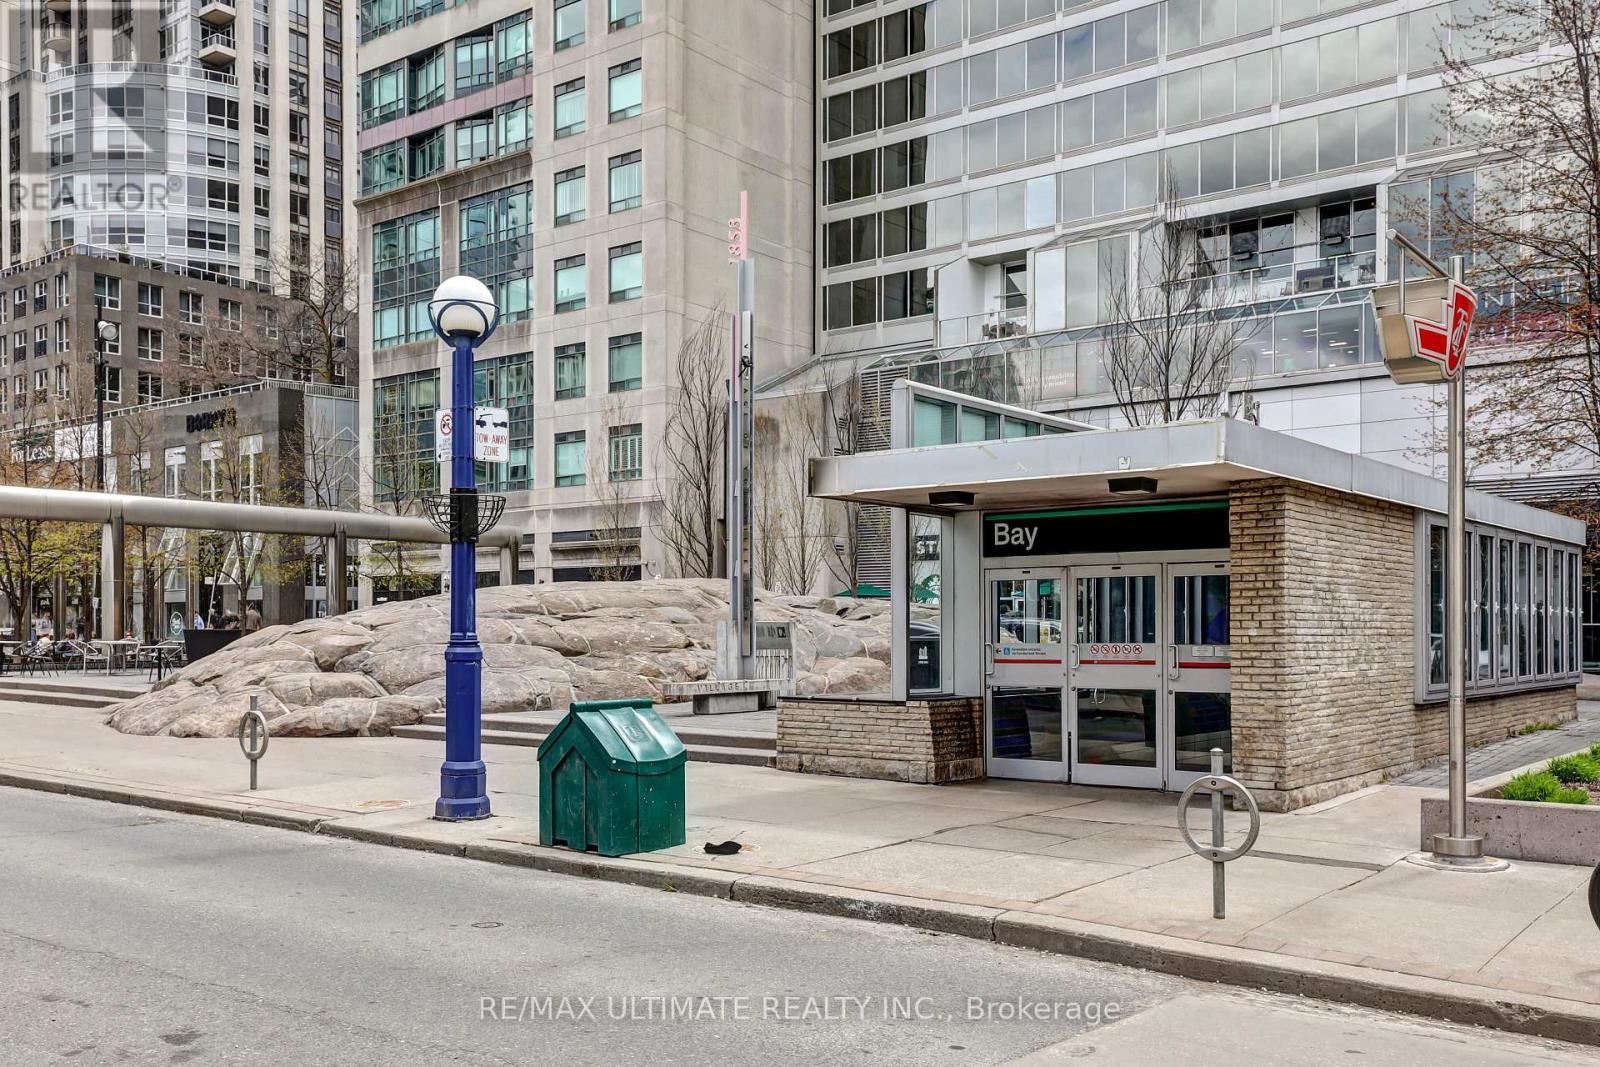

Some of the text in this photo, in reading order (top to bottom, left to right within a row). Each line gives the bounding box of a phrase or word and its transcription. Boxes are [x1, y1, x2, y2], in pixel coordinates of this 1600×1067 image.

[26, 445, 52, 461] Lease
[483, 445, 499, 457] ZONE
[994, 522, 1038, 551] Bay
